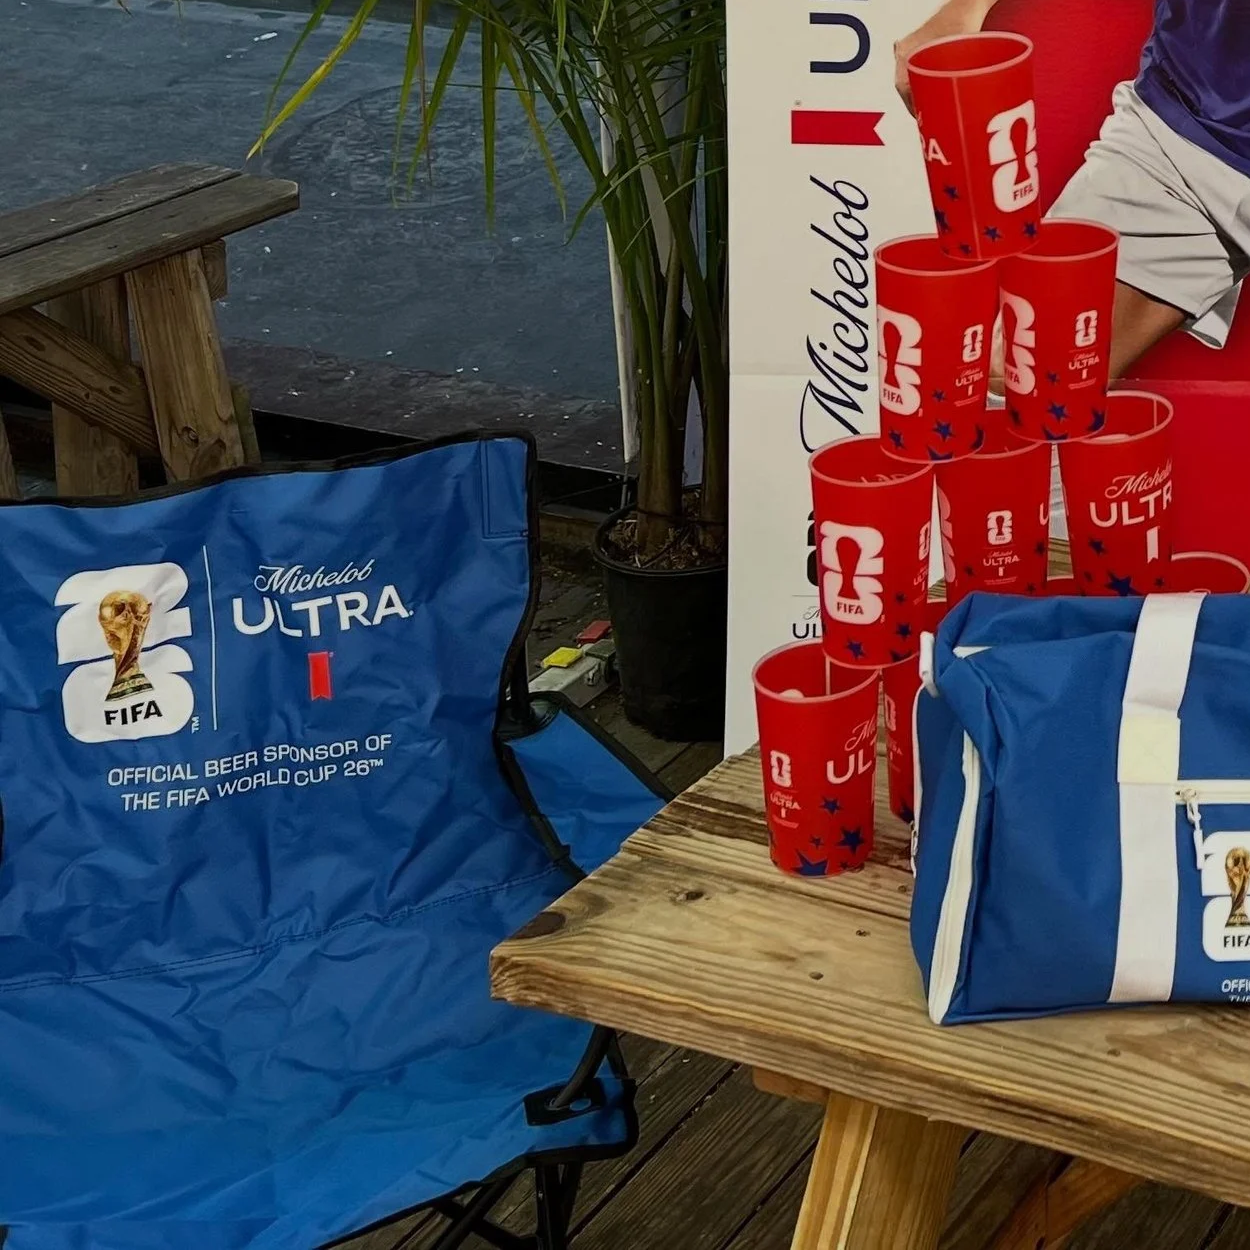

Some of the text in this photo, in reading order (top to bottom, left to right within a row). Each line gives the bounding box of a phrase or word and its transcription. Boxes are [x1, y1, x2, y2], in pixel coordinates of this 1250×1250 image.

[1013, 183, 1034, 201] FIFA
[800, 174, 870, 453] Michelob
[883, 388, 904, 405] FIFA
[1089, 479, 1172, 528] ULTR
[254, 558, 376, 595] Michelob
[983, 555, 1020, 566] ULTRA
[232, 584, 409, 638] ULTRA
[836, 601, 864, 615] FIFA
[104, 699, 163, 727] FIFA
[108, 733, 392, 787] OFFICIAL BEER SPONSOR OF
[121, 792, 160, 812] THE
[167, 787, 210, 809] FIFA
[216, 767, 290, 798] WORLD
[294, 765, 337, 787] CUP
